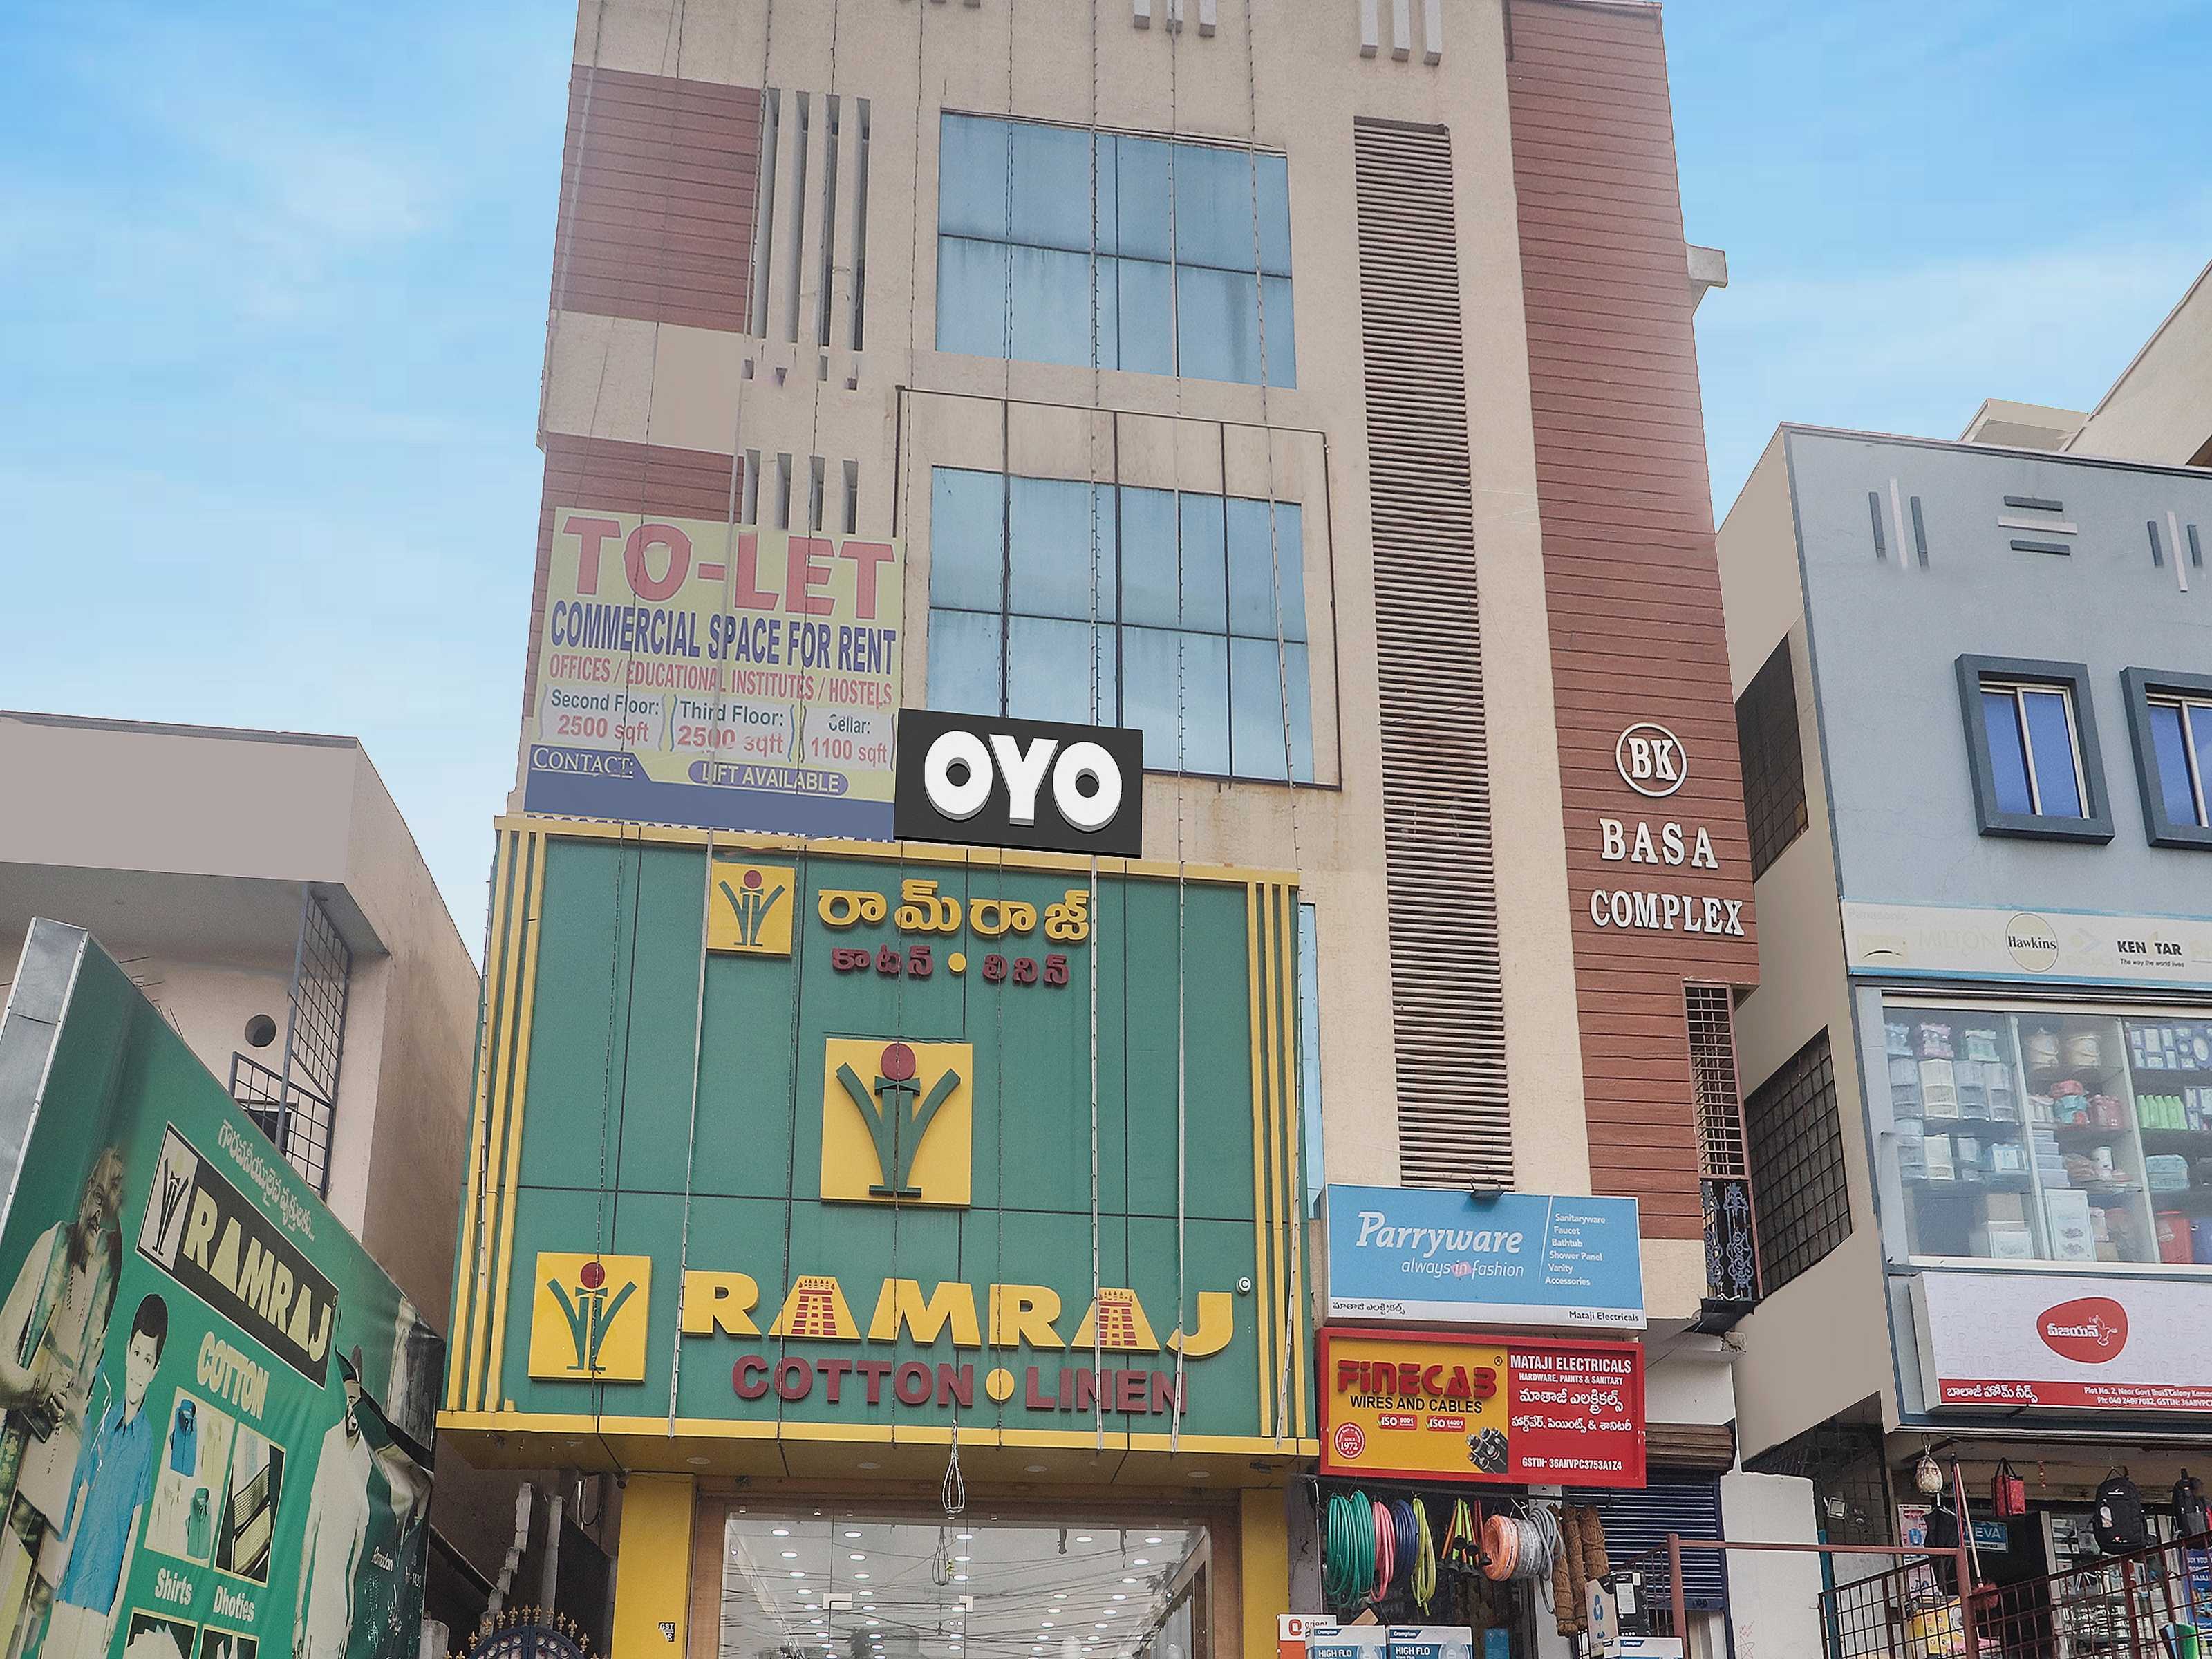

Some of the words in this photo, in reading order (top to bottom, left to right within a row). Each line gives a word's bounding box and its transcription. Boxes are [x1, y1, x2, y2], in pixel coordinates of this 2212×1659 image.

[563, 516, 894, 619] TO-LET
[551, 601, 700, 657] COMMERCIAL
[708, 613, 780, 665] SPACE
[787, 621, 831, 669] FOR
[838, 626, 896, 675] RENT
[550, 654, 610, 683] OFFICES
[626, 660, 726, 692] EDUCATIONAL
[732, 670, 814, 700] INSTITUTES
[829, 677, 892, 709] HOSTELS
[552, 689, 609, 711] Second
[680, 701, 726, 722] Third
[733, 706, 783, 726] Floor:
[829, 714, 870, 734] Cellar:
[557, 715, 608, 738] 2500
[615, 722, 648, 746] sqft
[677, 725, 735, 750] 2500
[812, 738, 852, 760] 1100
[859, 744, 887, 767] sqft
[1628, 738, 1677, 780] BK
[702, 763, 738, 782] LIFT
[742, 767, 839, 791] AVAILABLE
[924, 730, 1122, 833] OYO
[1600, 818, 1718, 869] BASA
[1590, 890, 1745, 936] COMPLEX
[2008, 935, 2056, 950] Hawkins
[832, 944, 934, 975] కాటన్
[1555, 1213, 1606, 1225] Sanitaryware
[1356, 1211, 1524, 1258] Parryware
[1554, 1226, 1580, 1235] Faucet
[1552, 1239, 1582, 1247] Bathtub
[1549, 1250, 1580, 1259] Shower
[1581, 1253, 1603, 1261] Panel
[182, 1185, 332, 1362] RAMRAJ
[1401, 1257, 1450, 1278] always
[1454, 1261, 1467, 1275] in
[1471, 1260, 1524, 1279] fashion
[1548, 1264, 1573, 1274] Vanity
[1545, 1277, 1591, 1286] Accessories
[682, 1271, 1232, 1358] RAMRAJ
[1569, 1311, 1595, 1323] Mataji
[1597, 1312, 1639, 1322] Electricals
[1510, 1355, 1552, 1369] MATAJI
[1556, 1357, 1631, 1373] ELECTRICALS
[197, 1331, 270, 1421] COTTON
[731, 1355, 973, 1407] COTTON
[1026, 1365, 1187, 1414] LINEN
[1519, 1373, 1558, 1383] HARDWARE,
[1559, 1375, 1583, 1383] PAINTS
[1591, 1376, 1623, 1385] SANITARY
[1351, 1395, 1393, 1409] WIRES
[1397, 1397, 1425, 1410] AND
[1429, 1399, 1482, 1413] CABLES
[1519, 1387, 1568, 1404] మాతాజీ
[1382, 1417, 1398, 1426] ISO
[1430, 1419, 1445, 1428] ISO
[1588, 1420, 1597, 1430] &
[1341, 1442, 1358, 1450] 1972
[154, 1568, 193, 1606] Shirts
[213, 1586, 255, 1622] Dhoties
[1318, 1649, 1337, 1658] HIGH
[1338, 1649, 1352, 1658] FLO
[1395, 1647, 1414, 1656] HIGH
[1416, 1647, 1430, 1656] FLO
